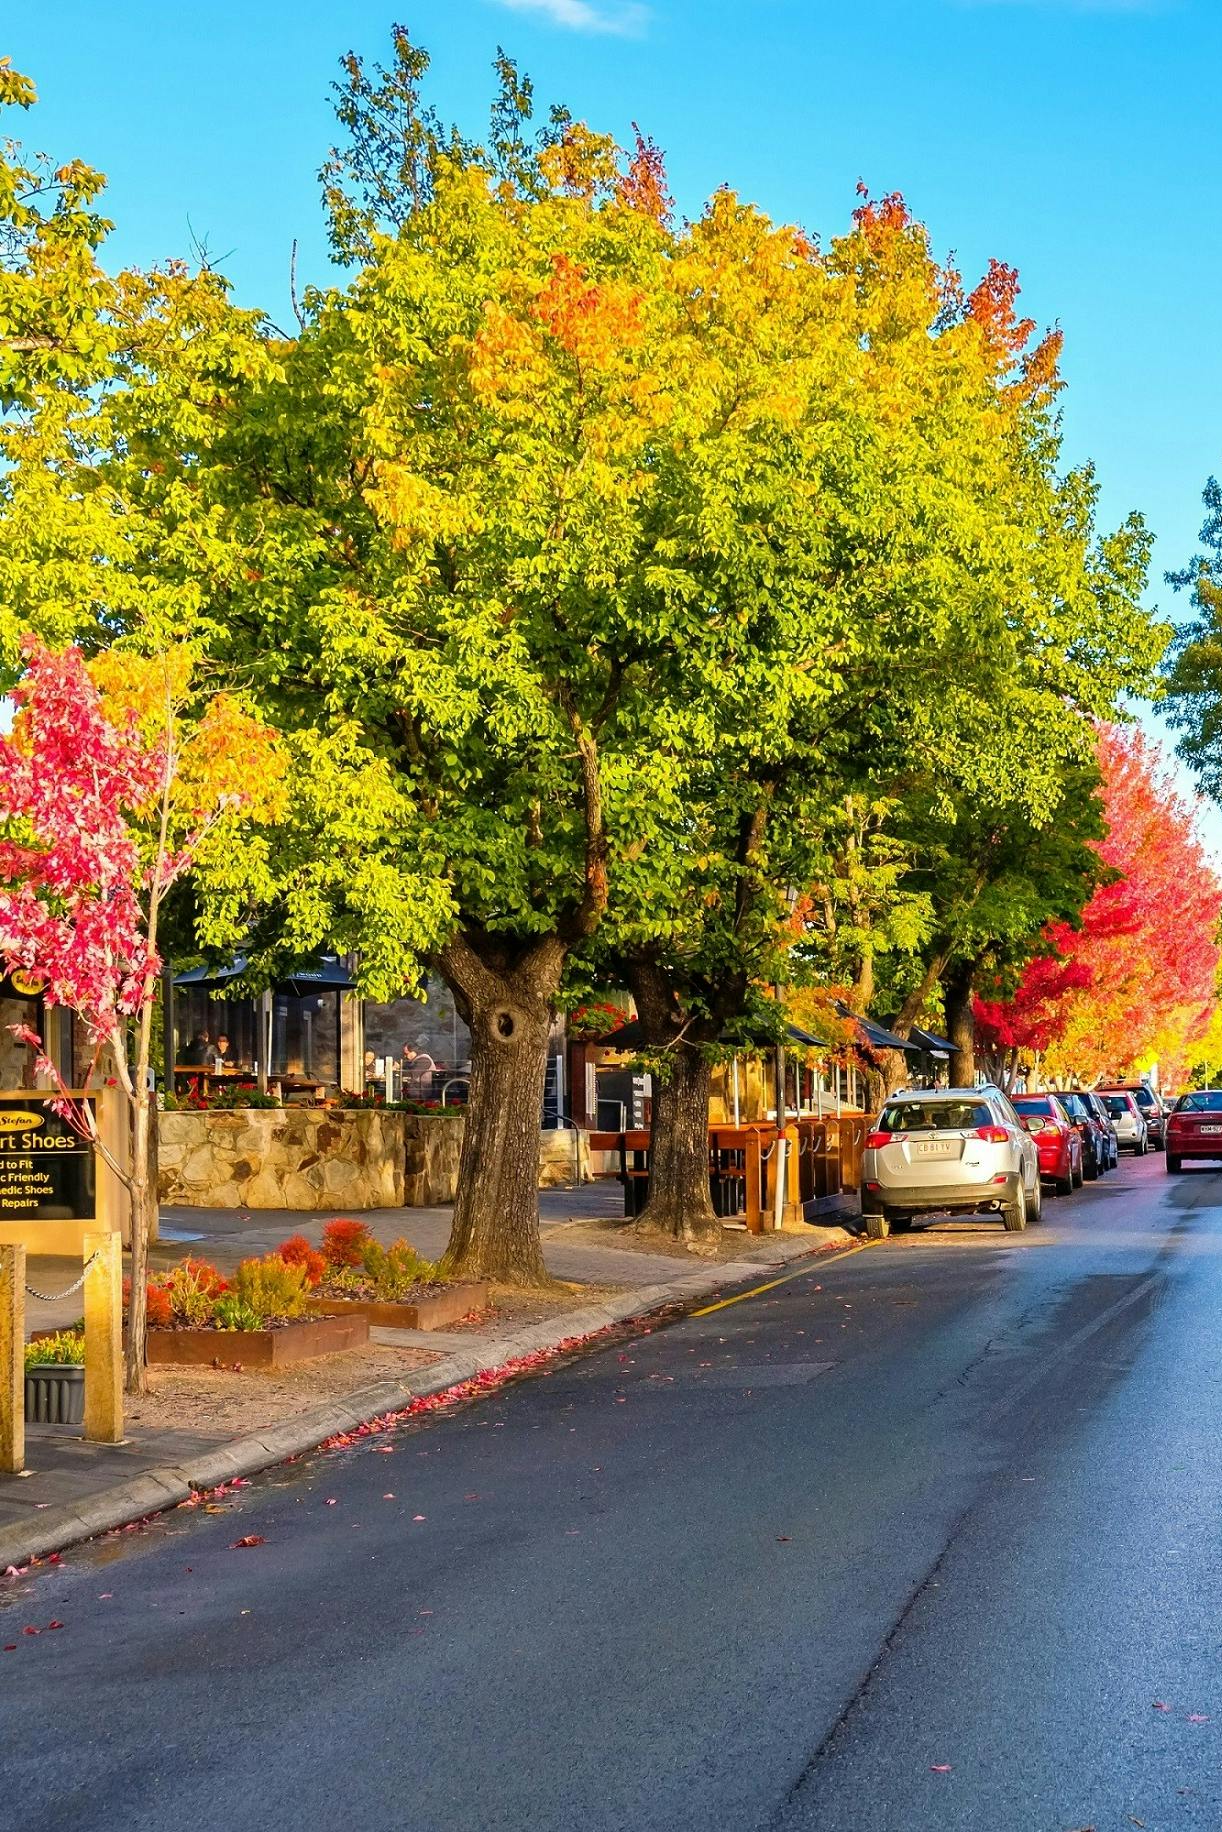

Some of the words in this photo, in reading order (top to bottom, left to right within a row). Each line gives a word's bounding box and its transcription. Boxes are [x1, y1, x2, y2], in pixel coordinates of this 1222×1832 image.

[1, 1116, 33, 1126] Stefan
[21, 1133, 75, 1149] Shoes
[6, 1161, 18, 1169] to
[19, 1160, 33, 1169] Fit
[8, 1172, 50, 1183] Friendly
[0, 1185, 23, 1195] edic
[24, 1185, 54, 1194] Shoes
[1, 1198, 39, 1209] Repairs
